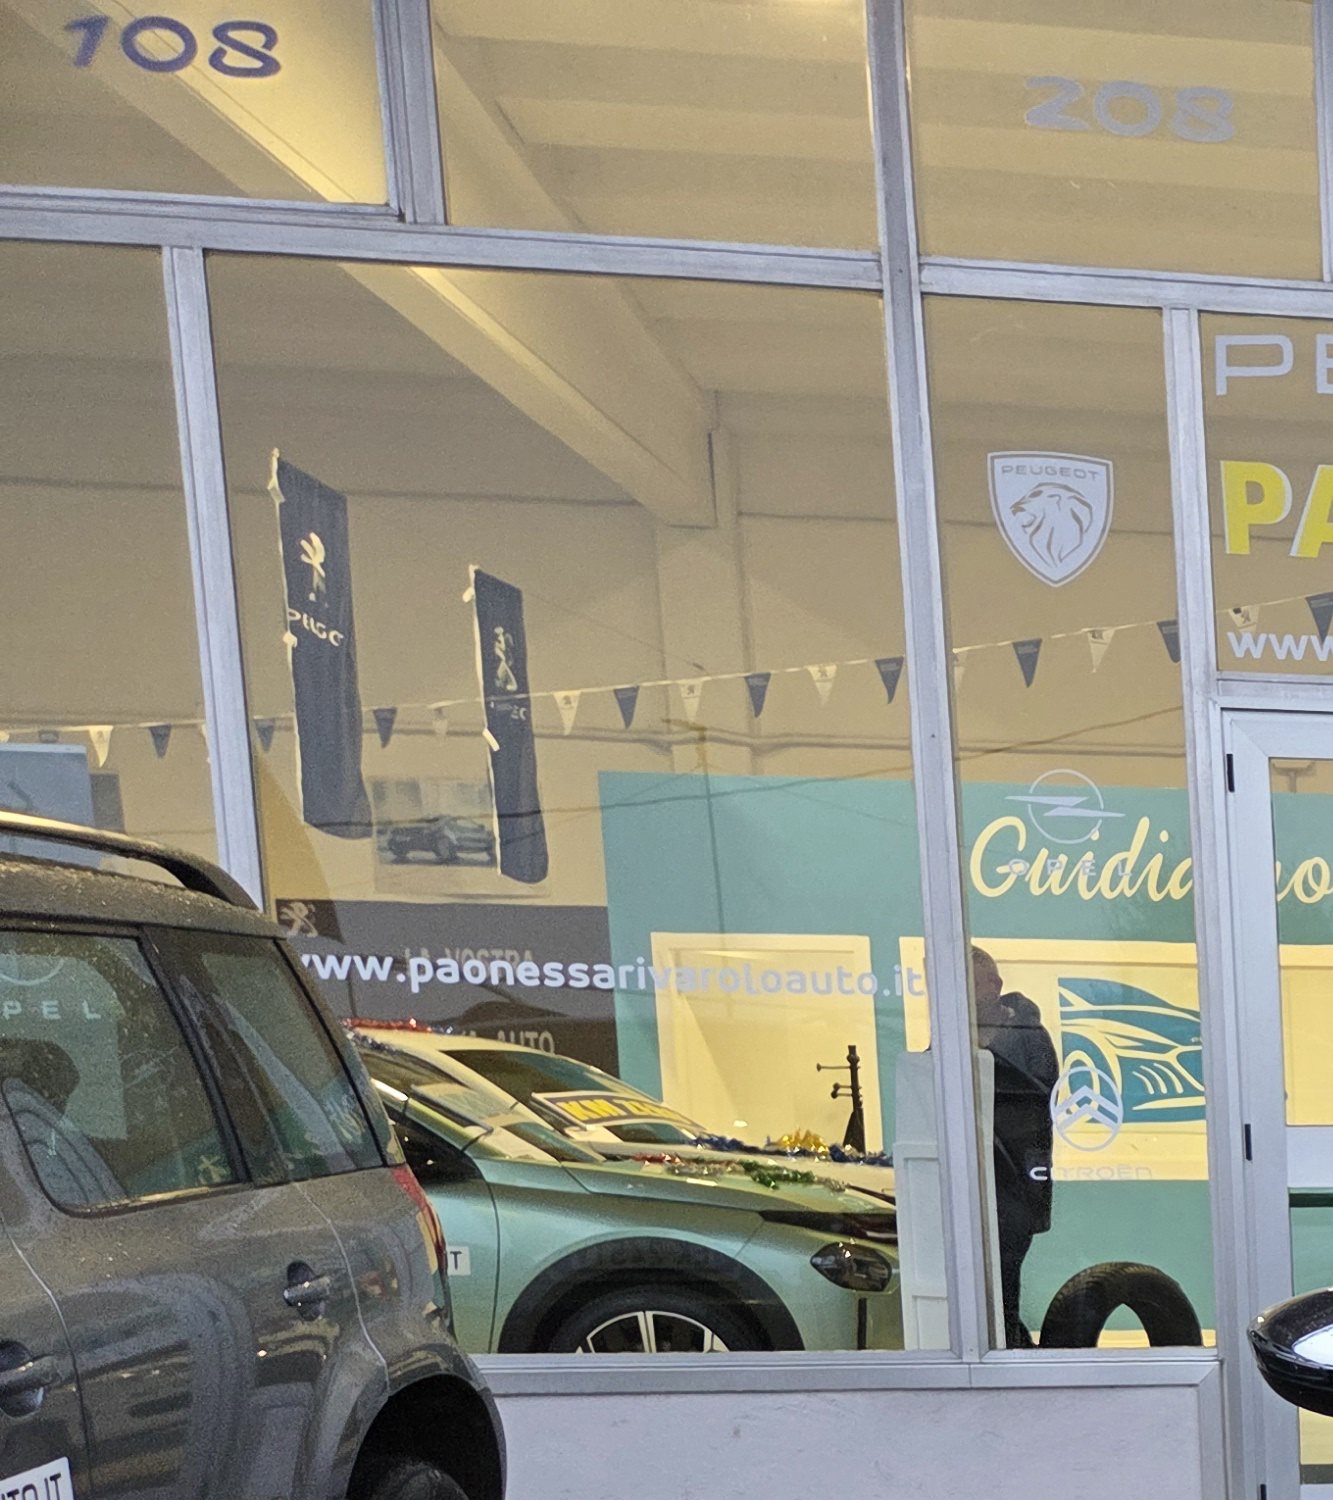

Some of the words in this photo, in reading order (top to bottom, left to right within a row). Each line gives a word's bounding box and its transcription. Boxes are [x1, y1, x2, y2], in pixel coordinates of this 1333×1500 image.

[65, 15, 282, 78] 108
[1023, 75, 1238, 143] 208
[1000, 462, 1101, 483] PEUGEOT
